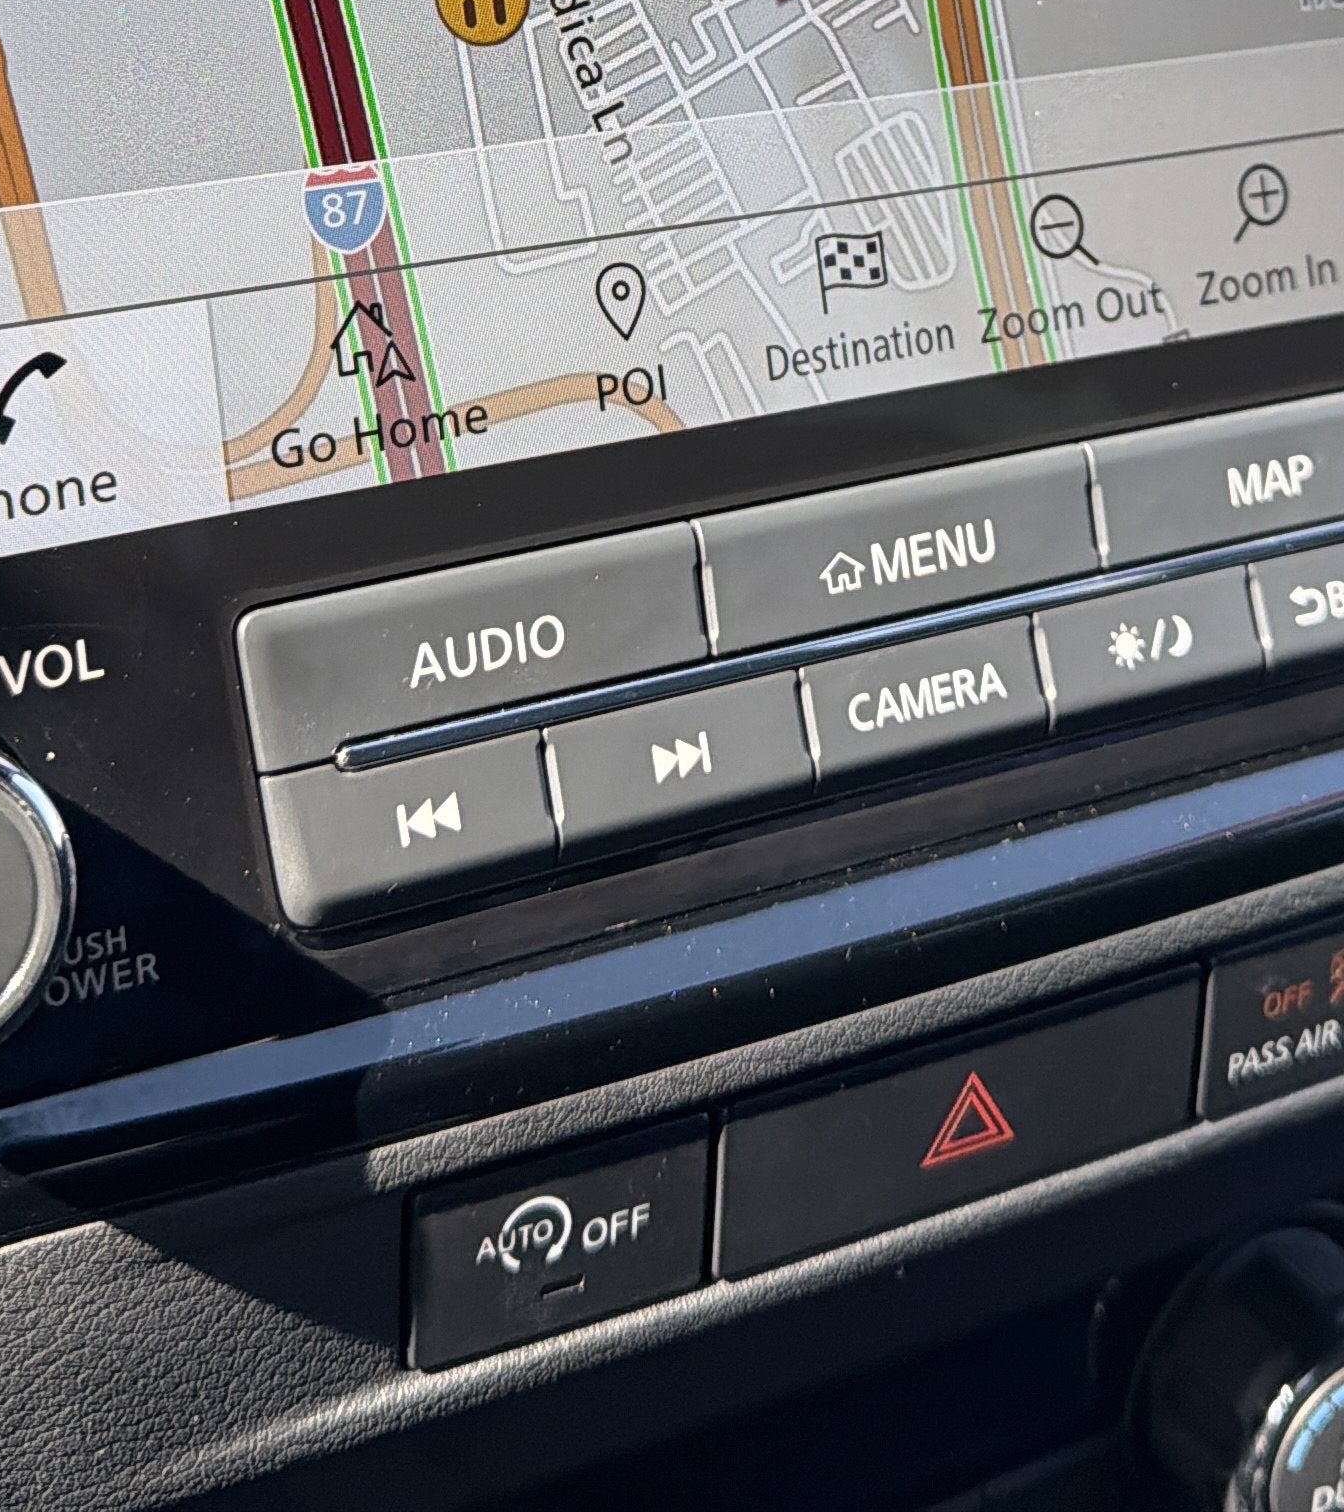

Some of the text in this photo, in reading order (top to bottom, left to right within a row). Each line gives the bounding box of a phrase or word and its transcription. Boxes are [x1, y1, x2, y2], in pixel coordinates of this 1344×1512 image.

[592, 101, 633, 164] Ln
[321, 190, 368, 229] 87
[1197, 254, 1338, 307] Zoom In
[978, 285, 1165, 345] Zoom Out
[767, 319, 955, 381] Destination
[596, 365, 669, 411] POI
[270, 403, 488, 469] Go Home
[1227, 454, 1316, 509] MAP
[870, 519, 997, 585] MENU
[411, 615, 566, 688] AUDIO
[848, 662, 1009, 733] CAMERA
[64, 926, 127, 965] USH
[45, 953, 160, 1007] OWER
[1264, 980, 1312, 1021] OFF
[1227, 1035, 1293, 1086] PASS
[1294, 1019, 1342, 1059] AIR
[476, 1202, 650, 1265] AUTO OFF
